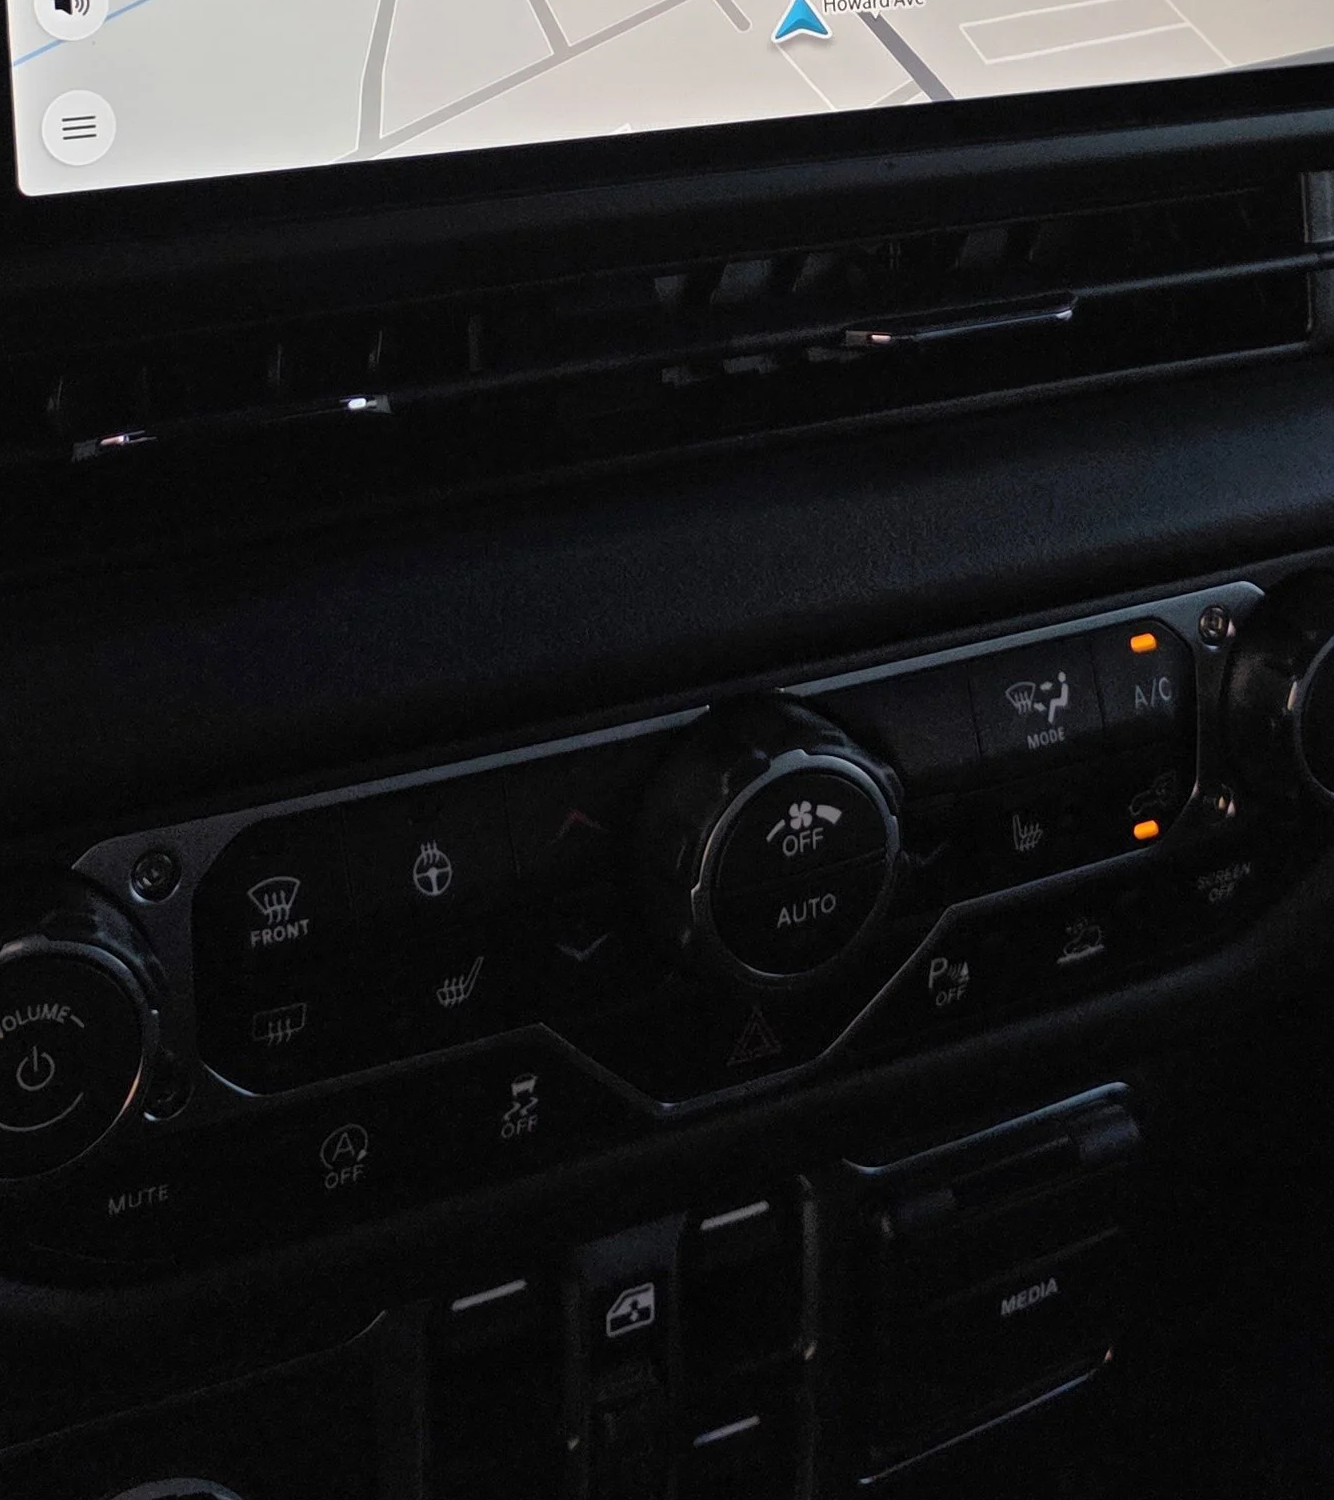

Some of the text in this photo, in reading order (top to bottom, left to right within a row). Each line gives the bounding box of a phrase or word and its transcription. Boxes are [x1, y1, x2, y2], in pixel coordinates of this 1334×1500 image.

[1134, 677, 1173, 710] A/C
[1027, 726, 1067, 750] MODE
[782, 827, 824, 856] OFF
[776, 893, 837, 929] AUTO
[250, 918, 310, 948] FRONT
[935, 985, 968, 1006] OFF
[500, 1114, 539, 1139] OFF
[324, 1164, 365, 1190] OFF
[107, 1184, 169, 1216] MUTE
[1000, 1276, 1059, 1317] MEDIA
